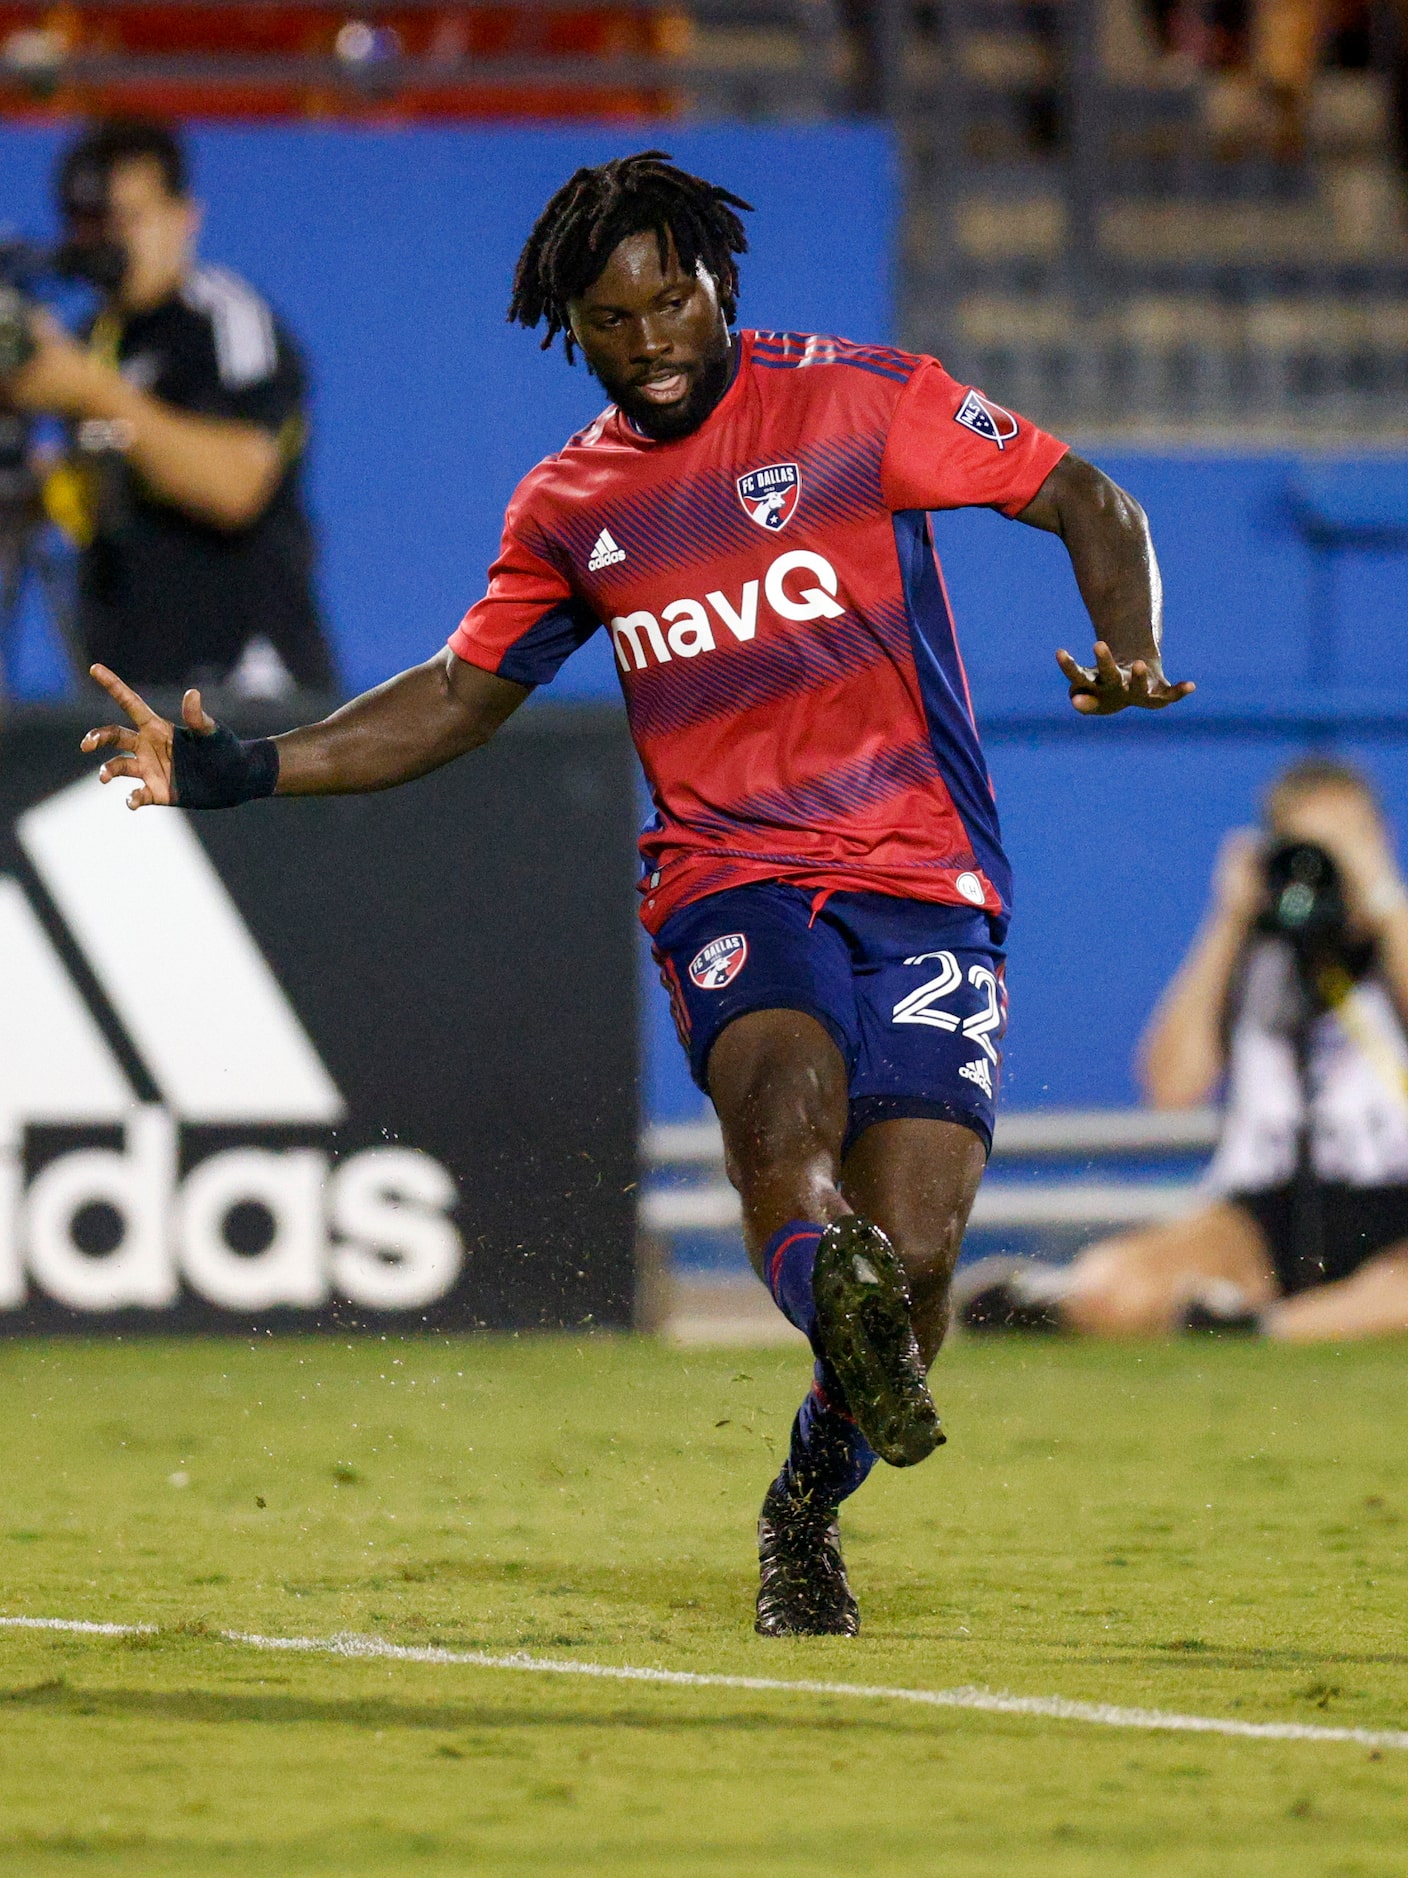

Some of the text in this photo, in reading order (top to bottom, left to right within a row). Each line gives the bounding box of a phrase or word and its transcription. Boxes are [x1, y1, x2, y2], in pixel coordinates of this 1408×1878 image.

[962, 403, 980, 424] MLS
[742, 476, 755, 494] FC
[757, 467, 795, 488] DALLAS
[588, 549, 627, 572] adidas
[611, 550, 846, 672] mavQ
[693, 956, 704, 974] FC
[703, 937, 740, 961] DALLAS
[892, 950, 999, 1065] 22
